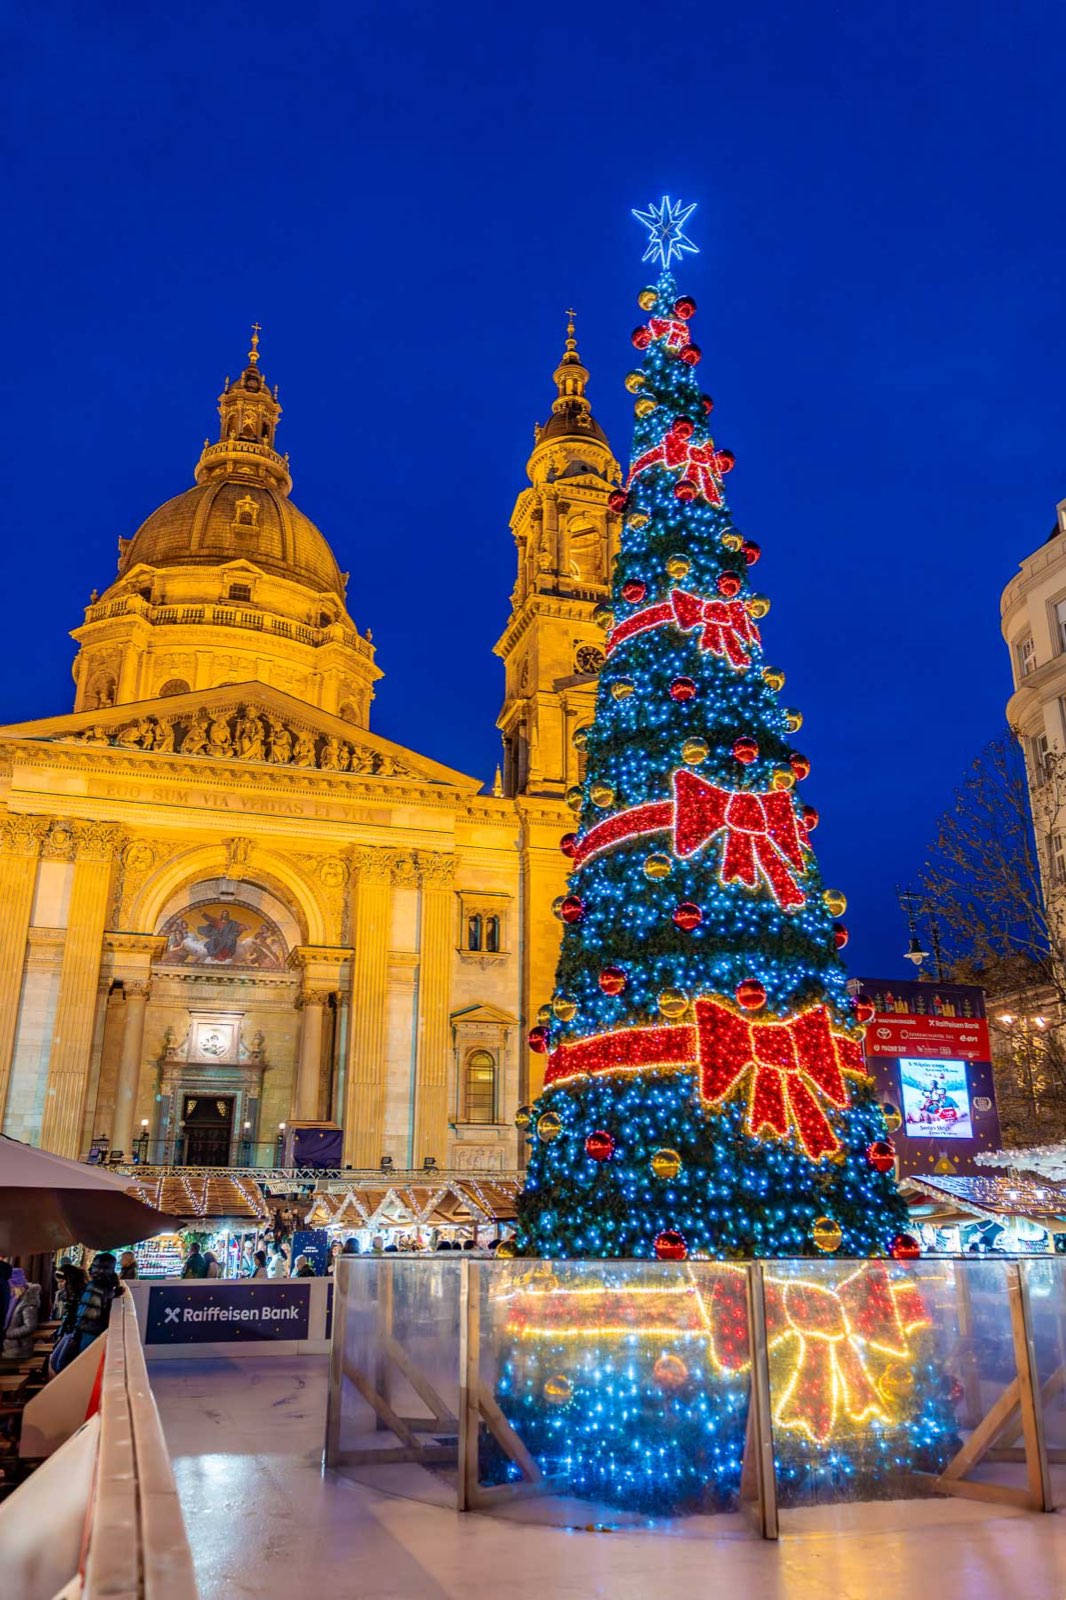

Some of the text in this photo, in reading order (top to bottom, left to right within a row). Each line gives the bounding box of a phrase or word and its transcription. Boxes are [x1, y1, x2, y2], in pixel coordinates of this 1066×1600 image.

[106, 784, 141, 799] EGO
[152, 787, 189, 803] SUM
[202, 792, 229, 807] VIA
[240, 796, 304, 815] VERITAS
[183, 1305, 299, 1322] Raiffeisen Bank
